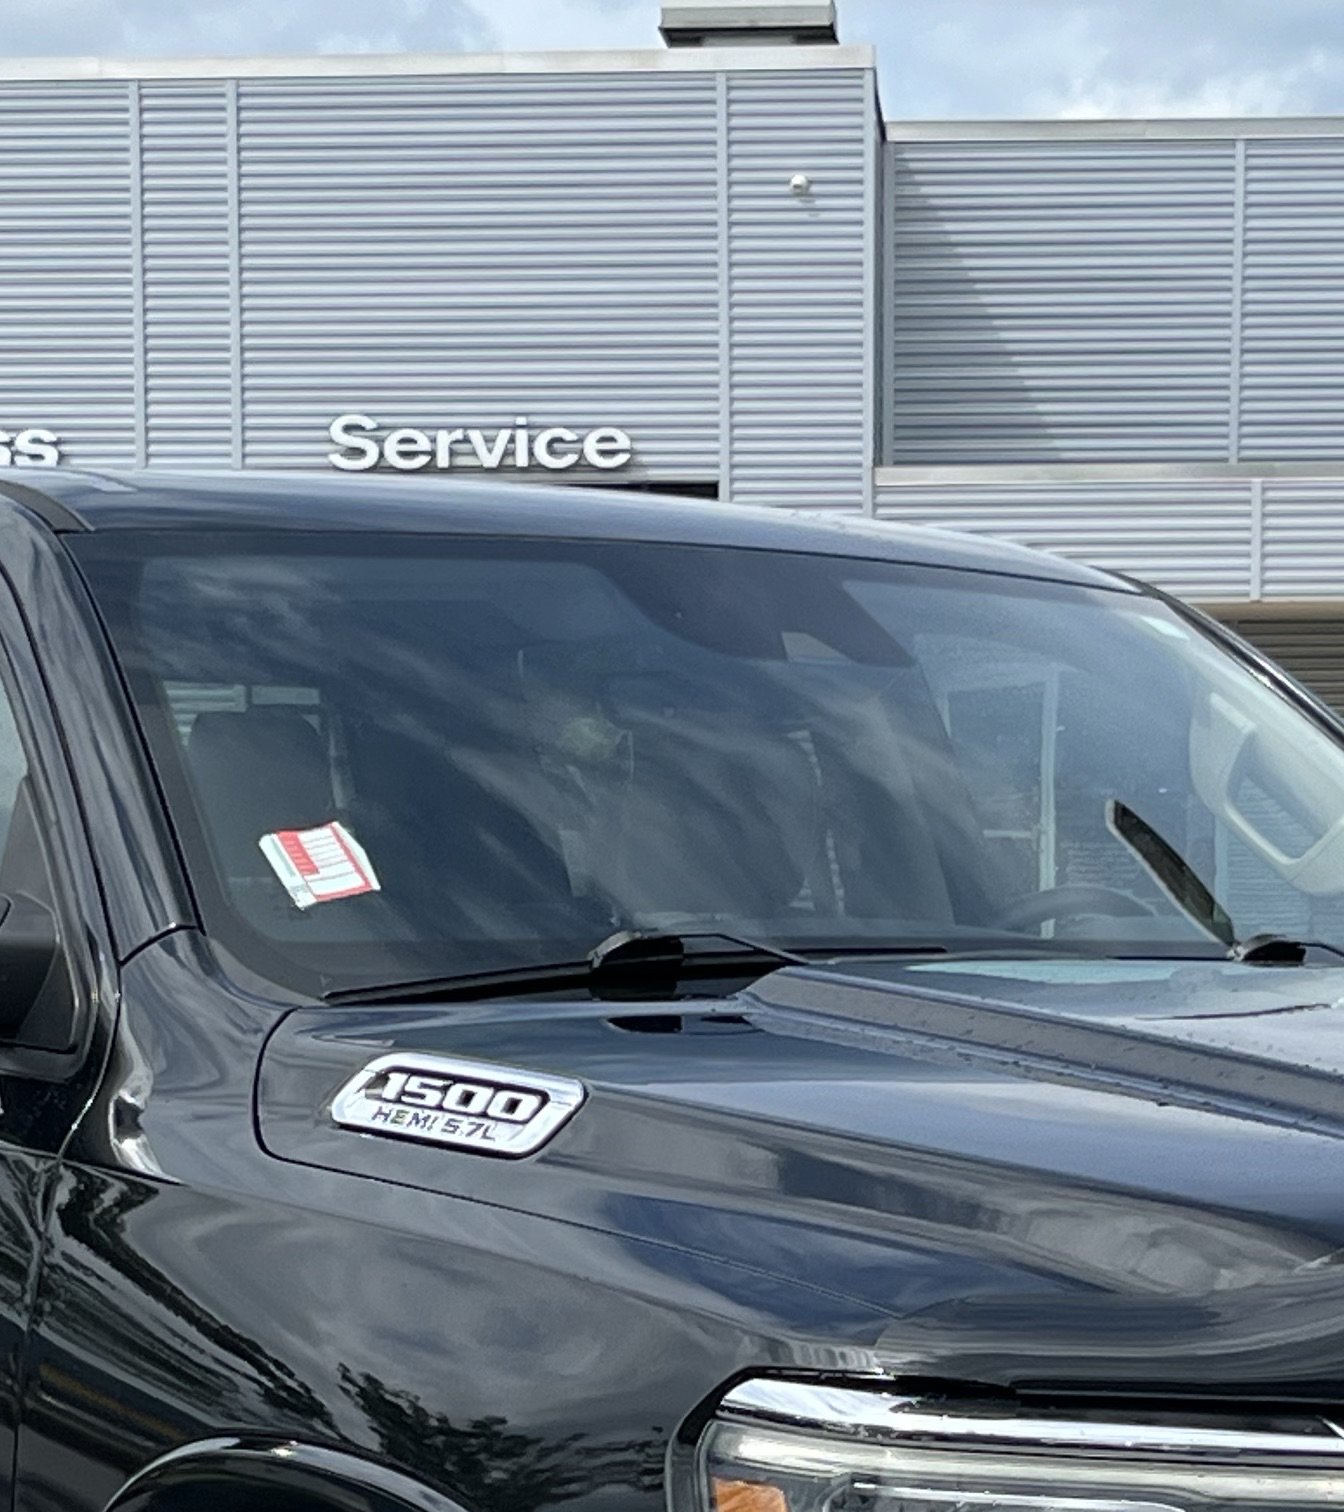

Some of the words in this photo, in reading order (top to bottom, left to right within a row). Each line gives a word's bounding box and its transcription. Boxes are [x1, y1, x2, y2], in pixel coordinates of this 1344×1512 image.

[327, 413, 632, 470] Service
[370, 1071, 544, 1123] 1500
[371, 1105, 439, 1132] HEMI
[441, 1117, 497, 1142] 5.7L
